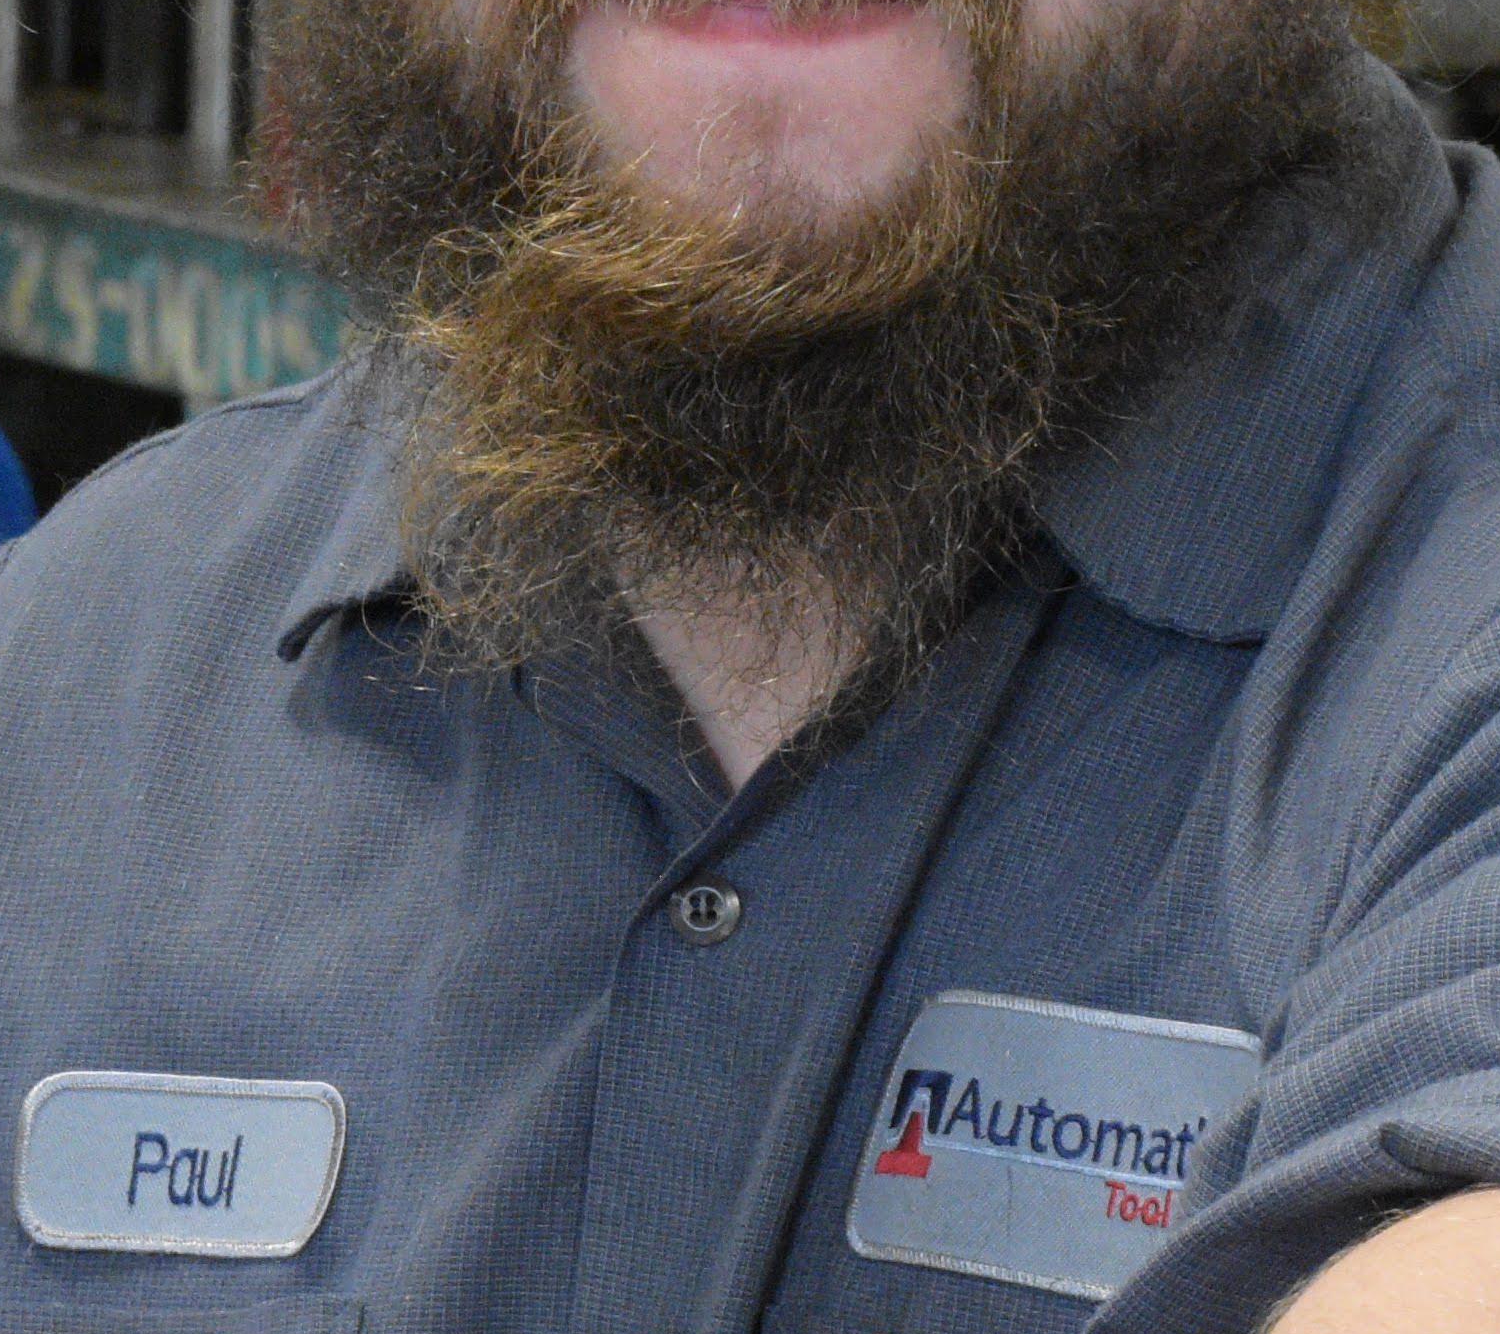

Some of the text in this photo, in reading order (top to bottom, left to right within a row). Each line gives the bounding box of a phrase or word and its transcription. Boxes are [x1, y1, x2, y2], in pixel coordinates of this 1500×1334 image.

[943, 1076, 1208, 1179] Automat
[127, 1131, 243, 1208] Paul
[1104, 1180, 1174, 1228] Tool
